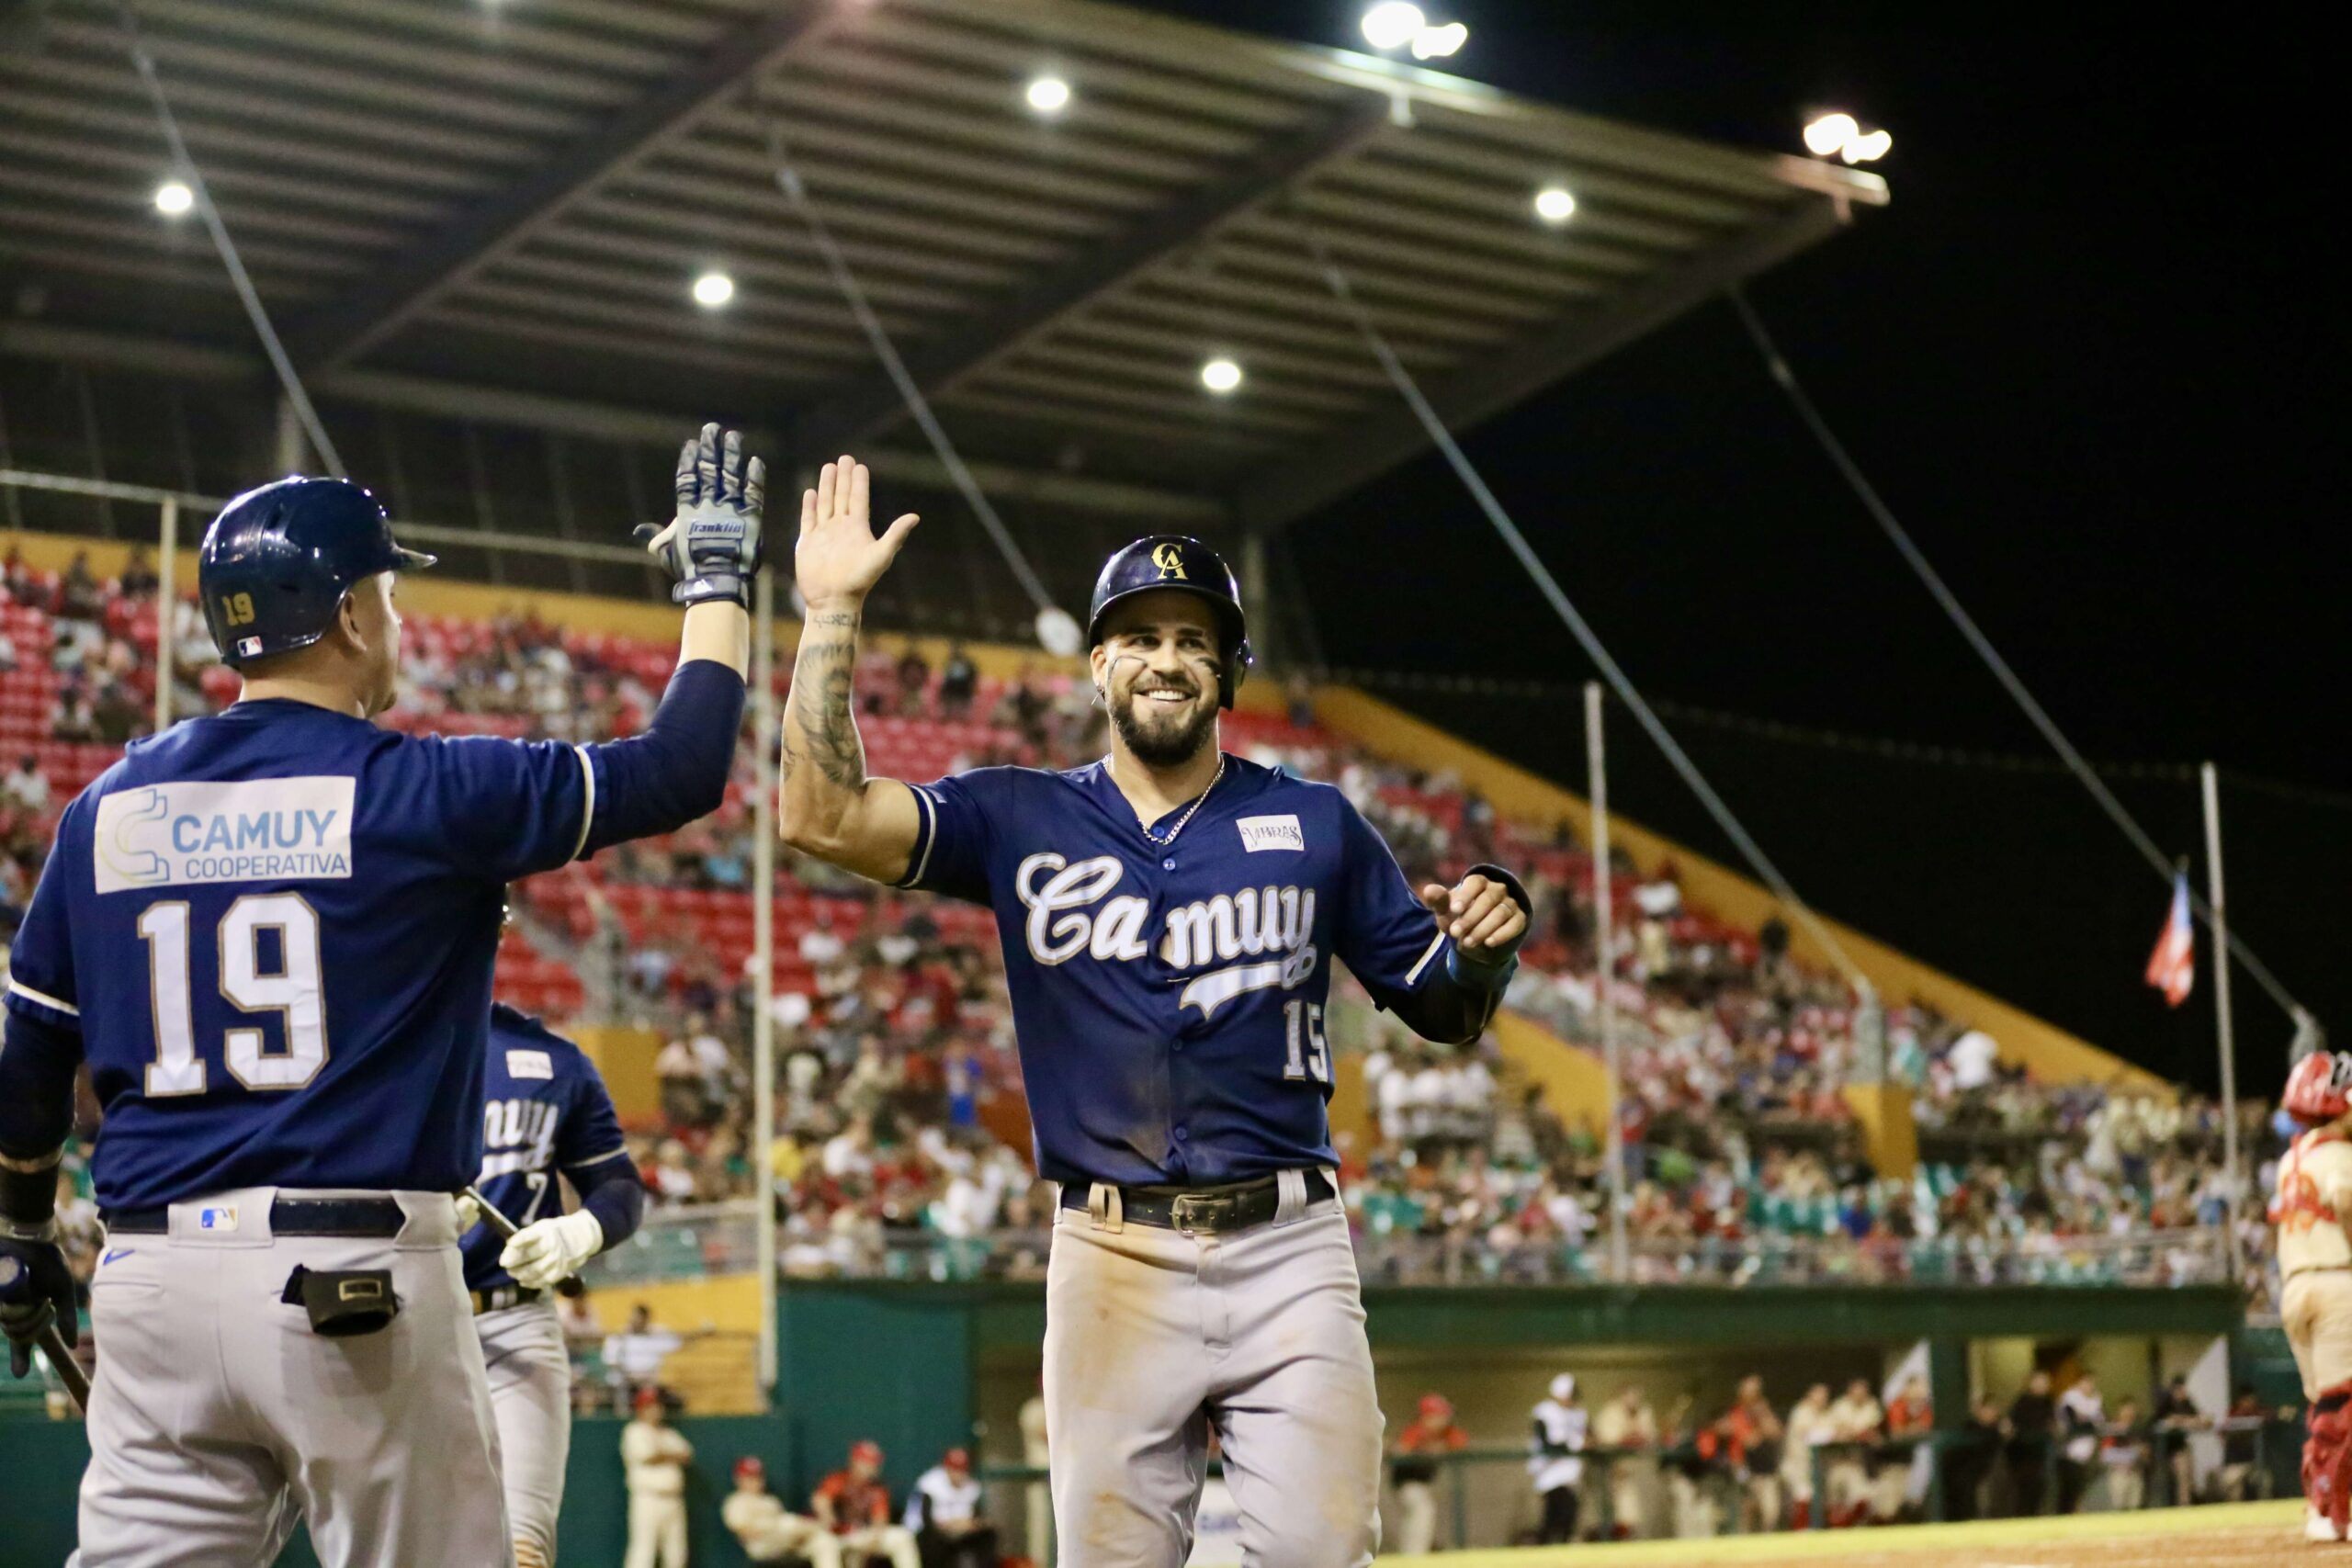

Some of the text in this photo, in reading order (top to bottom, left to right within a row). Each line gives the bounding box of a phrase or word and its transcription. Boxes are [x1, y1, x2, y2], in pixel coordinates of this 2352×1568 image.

[221, 592, 255, 626] 19
[172, 808, 337, 853] CAMUY
[186, 852, 348, 880] COOPERATIVA
[137, 891, 330, 1098] 19
[1283, 999, 1329, 1083] 15
